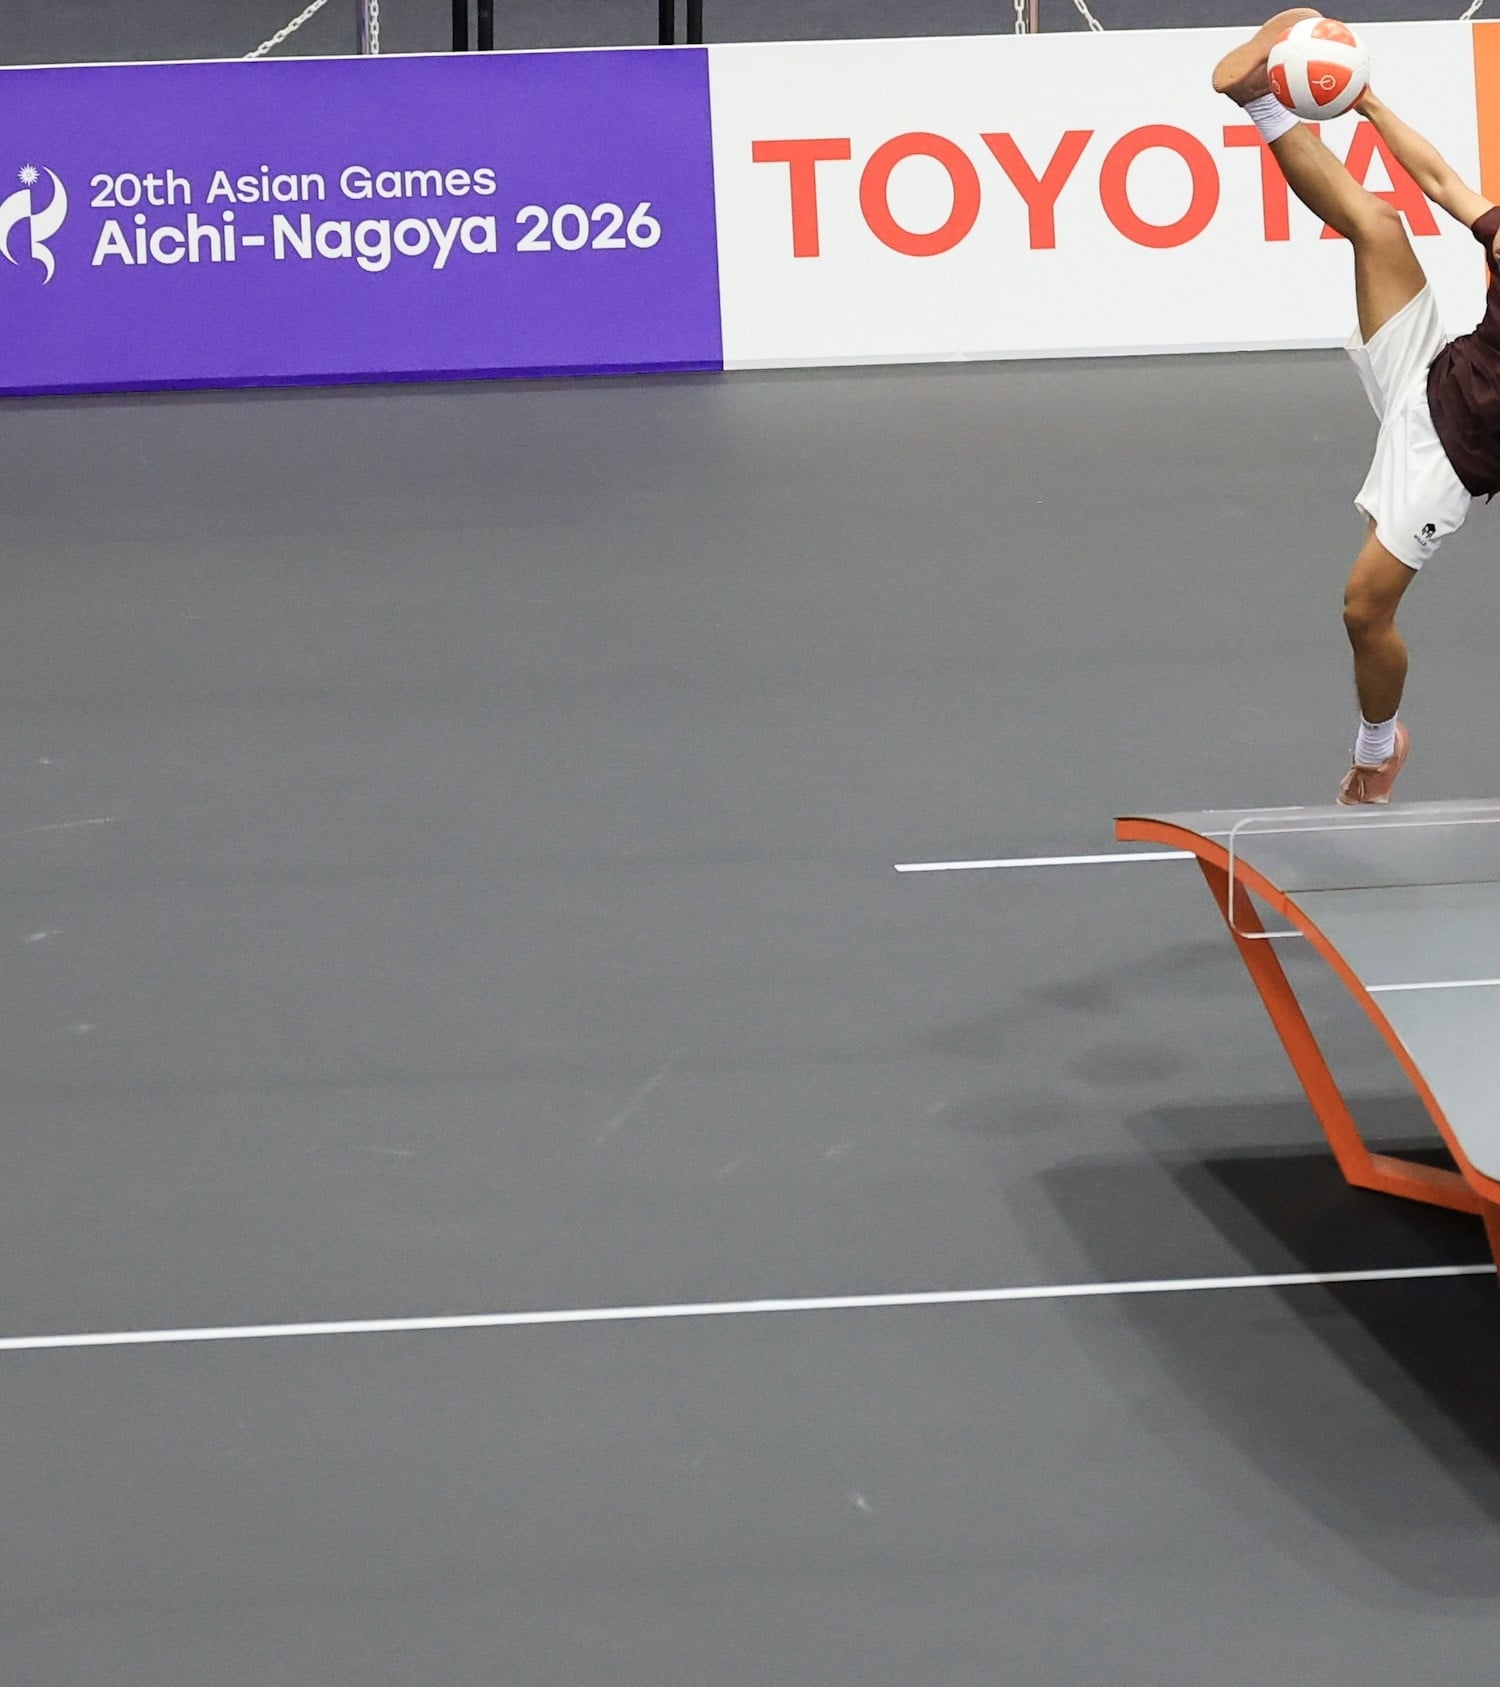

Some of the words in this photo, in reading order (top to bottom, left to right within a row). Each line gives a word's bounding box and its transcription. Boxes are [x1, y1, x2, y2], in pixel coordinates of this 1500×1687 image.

[90, 173, 191, 208] 20th
[206, 165, 325, 204] Asian
[340, 164, 497, 200] Games
[751, 123, 1441, 258] TOYOTA
[91, 210, 497, 272] Aichi-Nagoya
[516, 202, 661, 252] 2026
